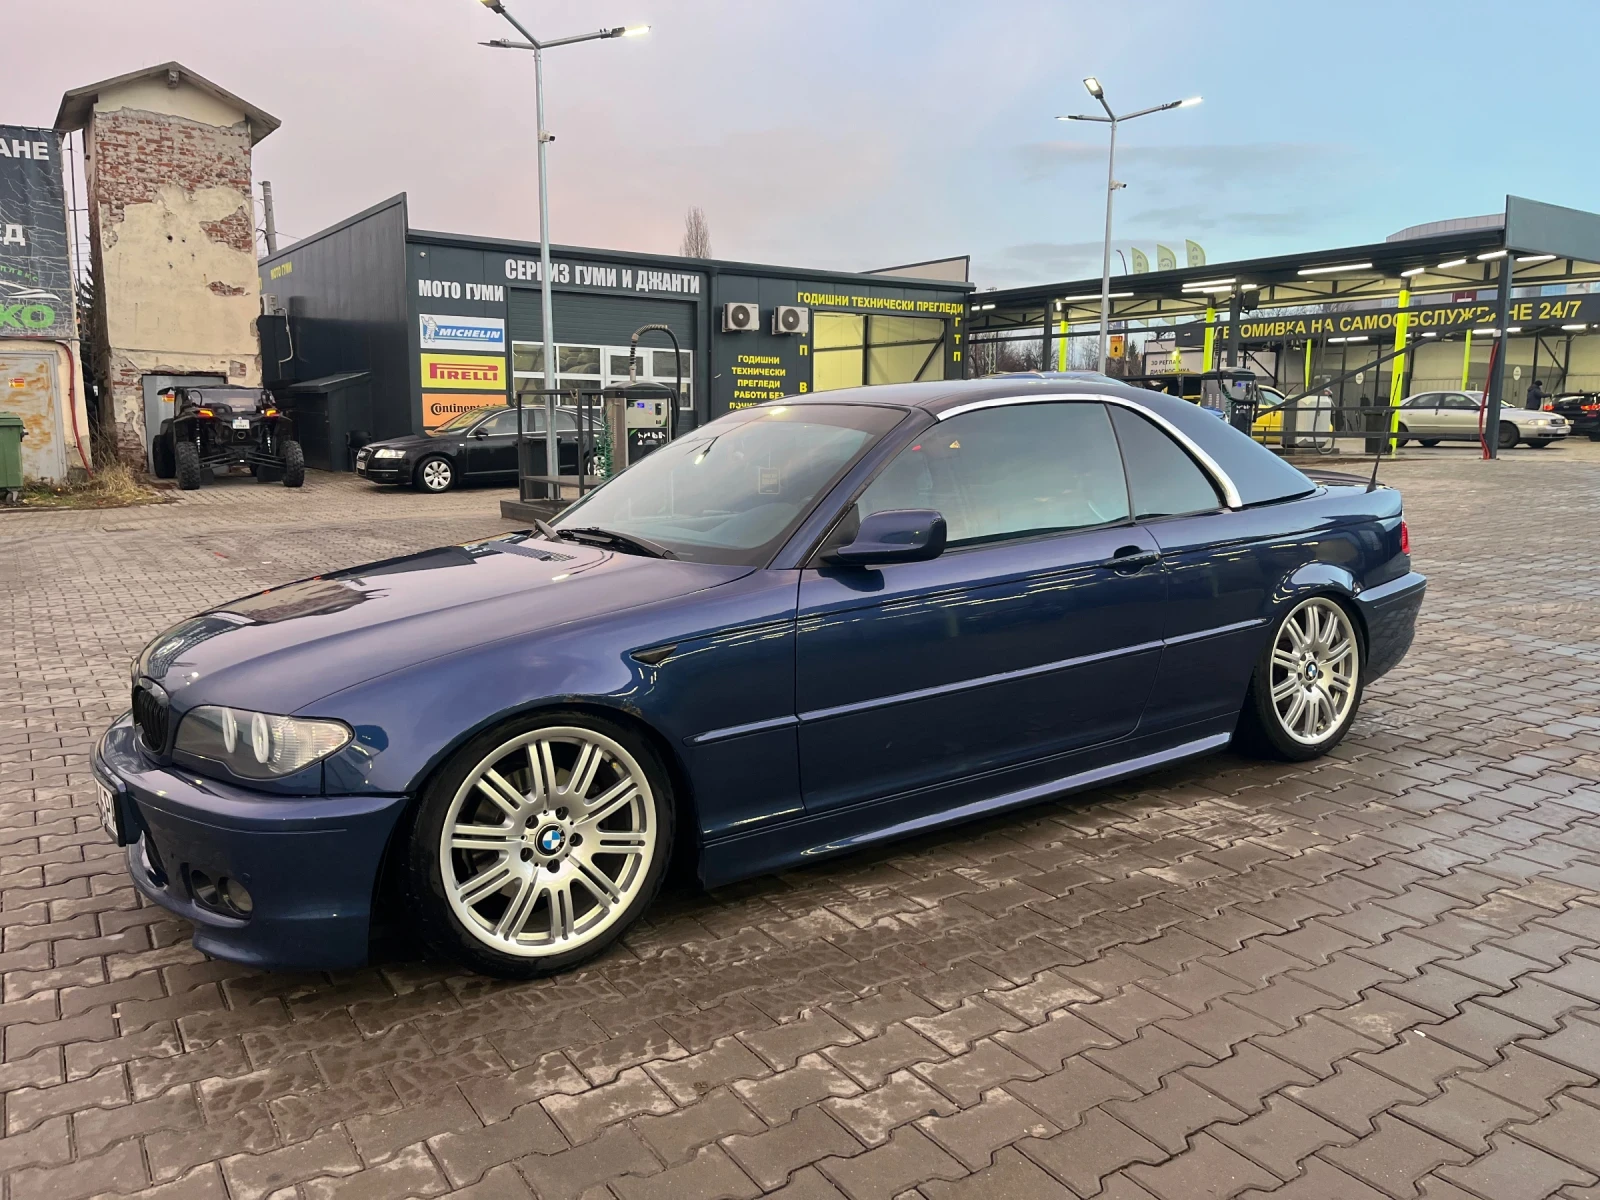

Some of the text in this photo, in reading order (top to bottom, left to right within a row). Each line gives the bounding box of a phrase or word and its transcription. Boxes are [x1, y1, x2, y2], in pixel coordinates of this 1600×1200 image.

[0, 223, 26, 246] Д
[575, 265, 617, 288] ГУМИ
[621, 269, 633, 289] И
[636, 269, 700, 294] ДЖАНТИ
[418, 279, 504, 302] МОТО ГУМИ
[797, 291, 964, 315] ГОДИШНИ ТЕХНИЧЕСКИ ПРЕГЛЕДИ
[1212, 320, 1306, 340] ВОМИВКА
[1311, 318, 1334, 333] НА
[1538, 300, 1582, 320] 24/7
[439, 328, 501, 339] MICHELIN
[738, 355, 780, 365] ГОДИШНИ
[430, 363, 498, 381] PIRELLI
[731, 366, 786, 377] ТЕХНИЧЕСКИ
[737, 379, 780, 389] ПРЕГЛЕДИ
[734, 391, 785, 400] РАБОТИ БЕЗ
[430, 402, 495, 416] Continen
